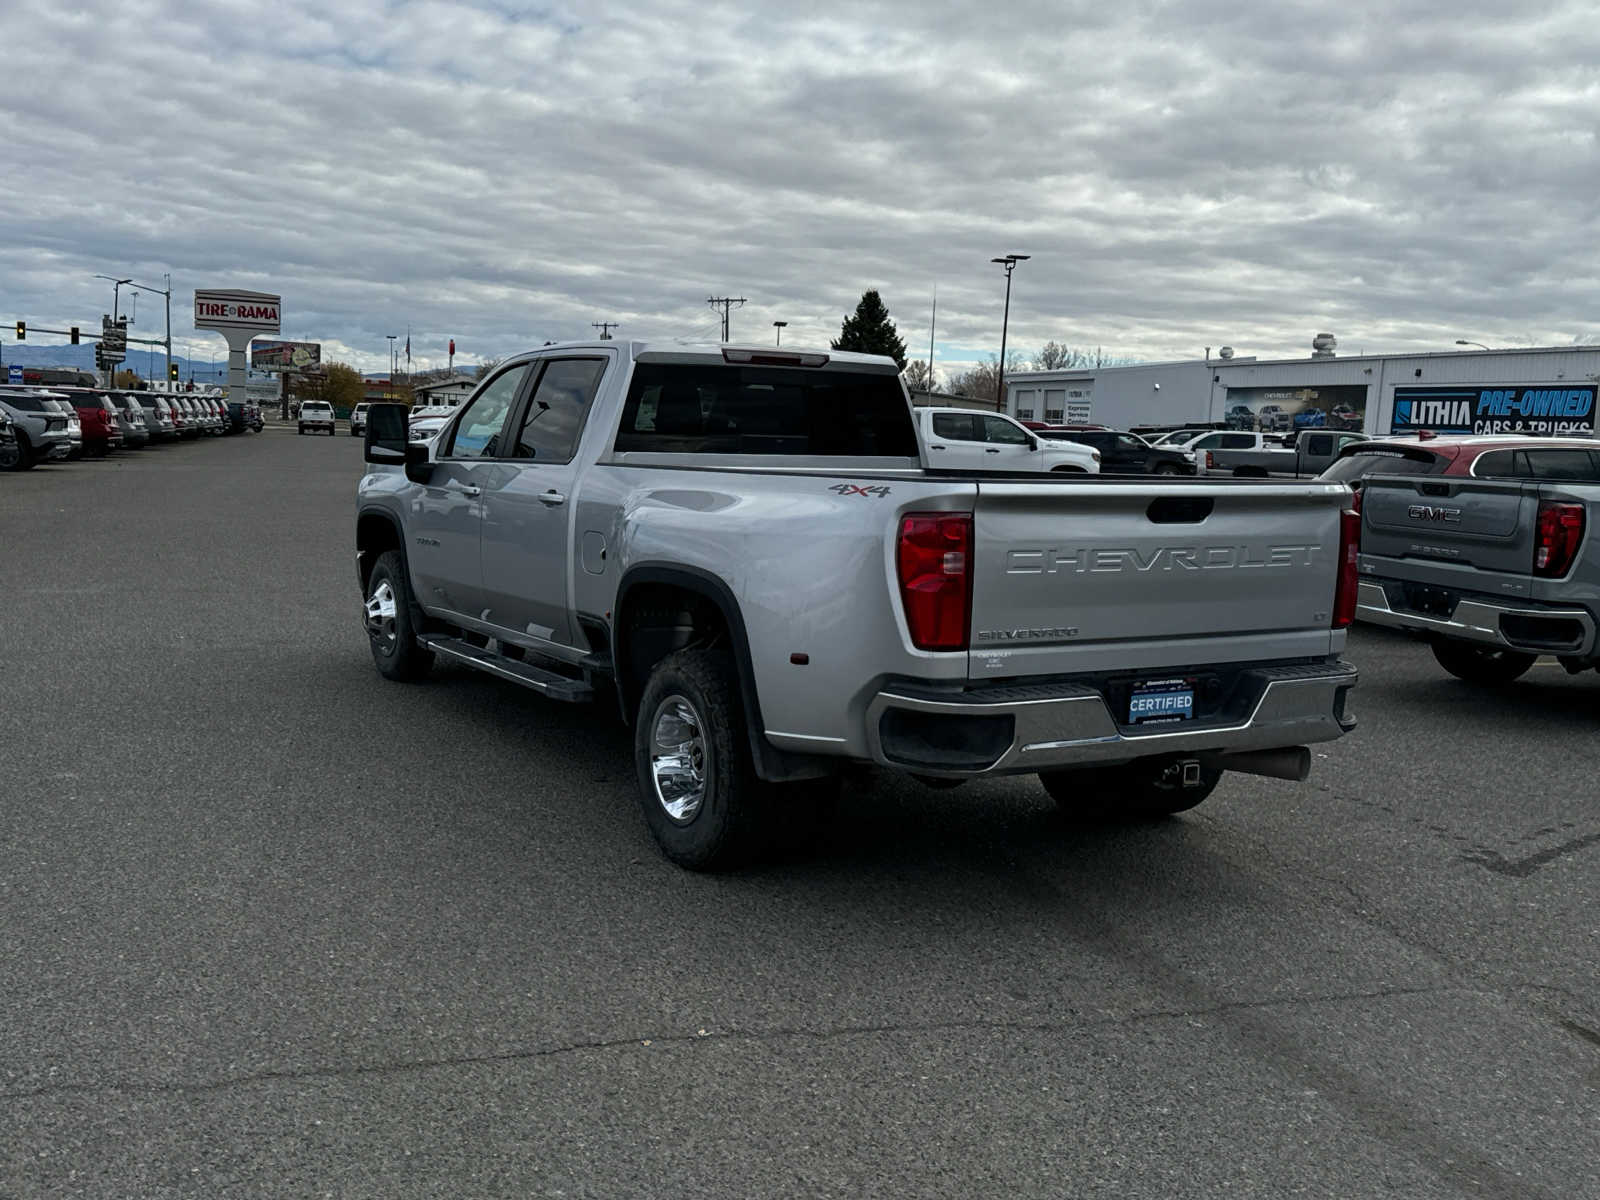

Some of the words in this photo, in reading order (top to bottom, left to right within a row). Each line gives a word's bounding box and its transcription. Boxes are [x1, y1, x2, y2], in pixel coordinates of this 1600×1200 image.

[197, 302, 229, 317] TIRE
[237, 305, 278, 320] RAMA
[1410, 400, 1471, 425] LITHIA
[1476, 390, 1593, 417] PRE-OWNED
[1408, 505, 1461, 523] GMC
[1006, 543, 1321, 575] CHEVROLET
[978, 626, 1080, 641] SILVERADO
[1129, 695, 1192, 712] CERTIFIED
